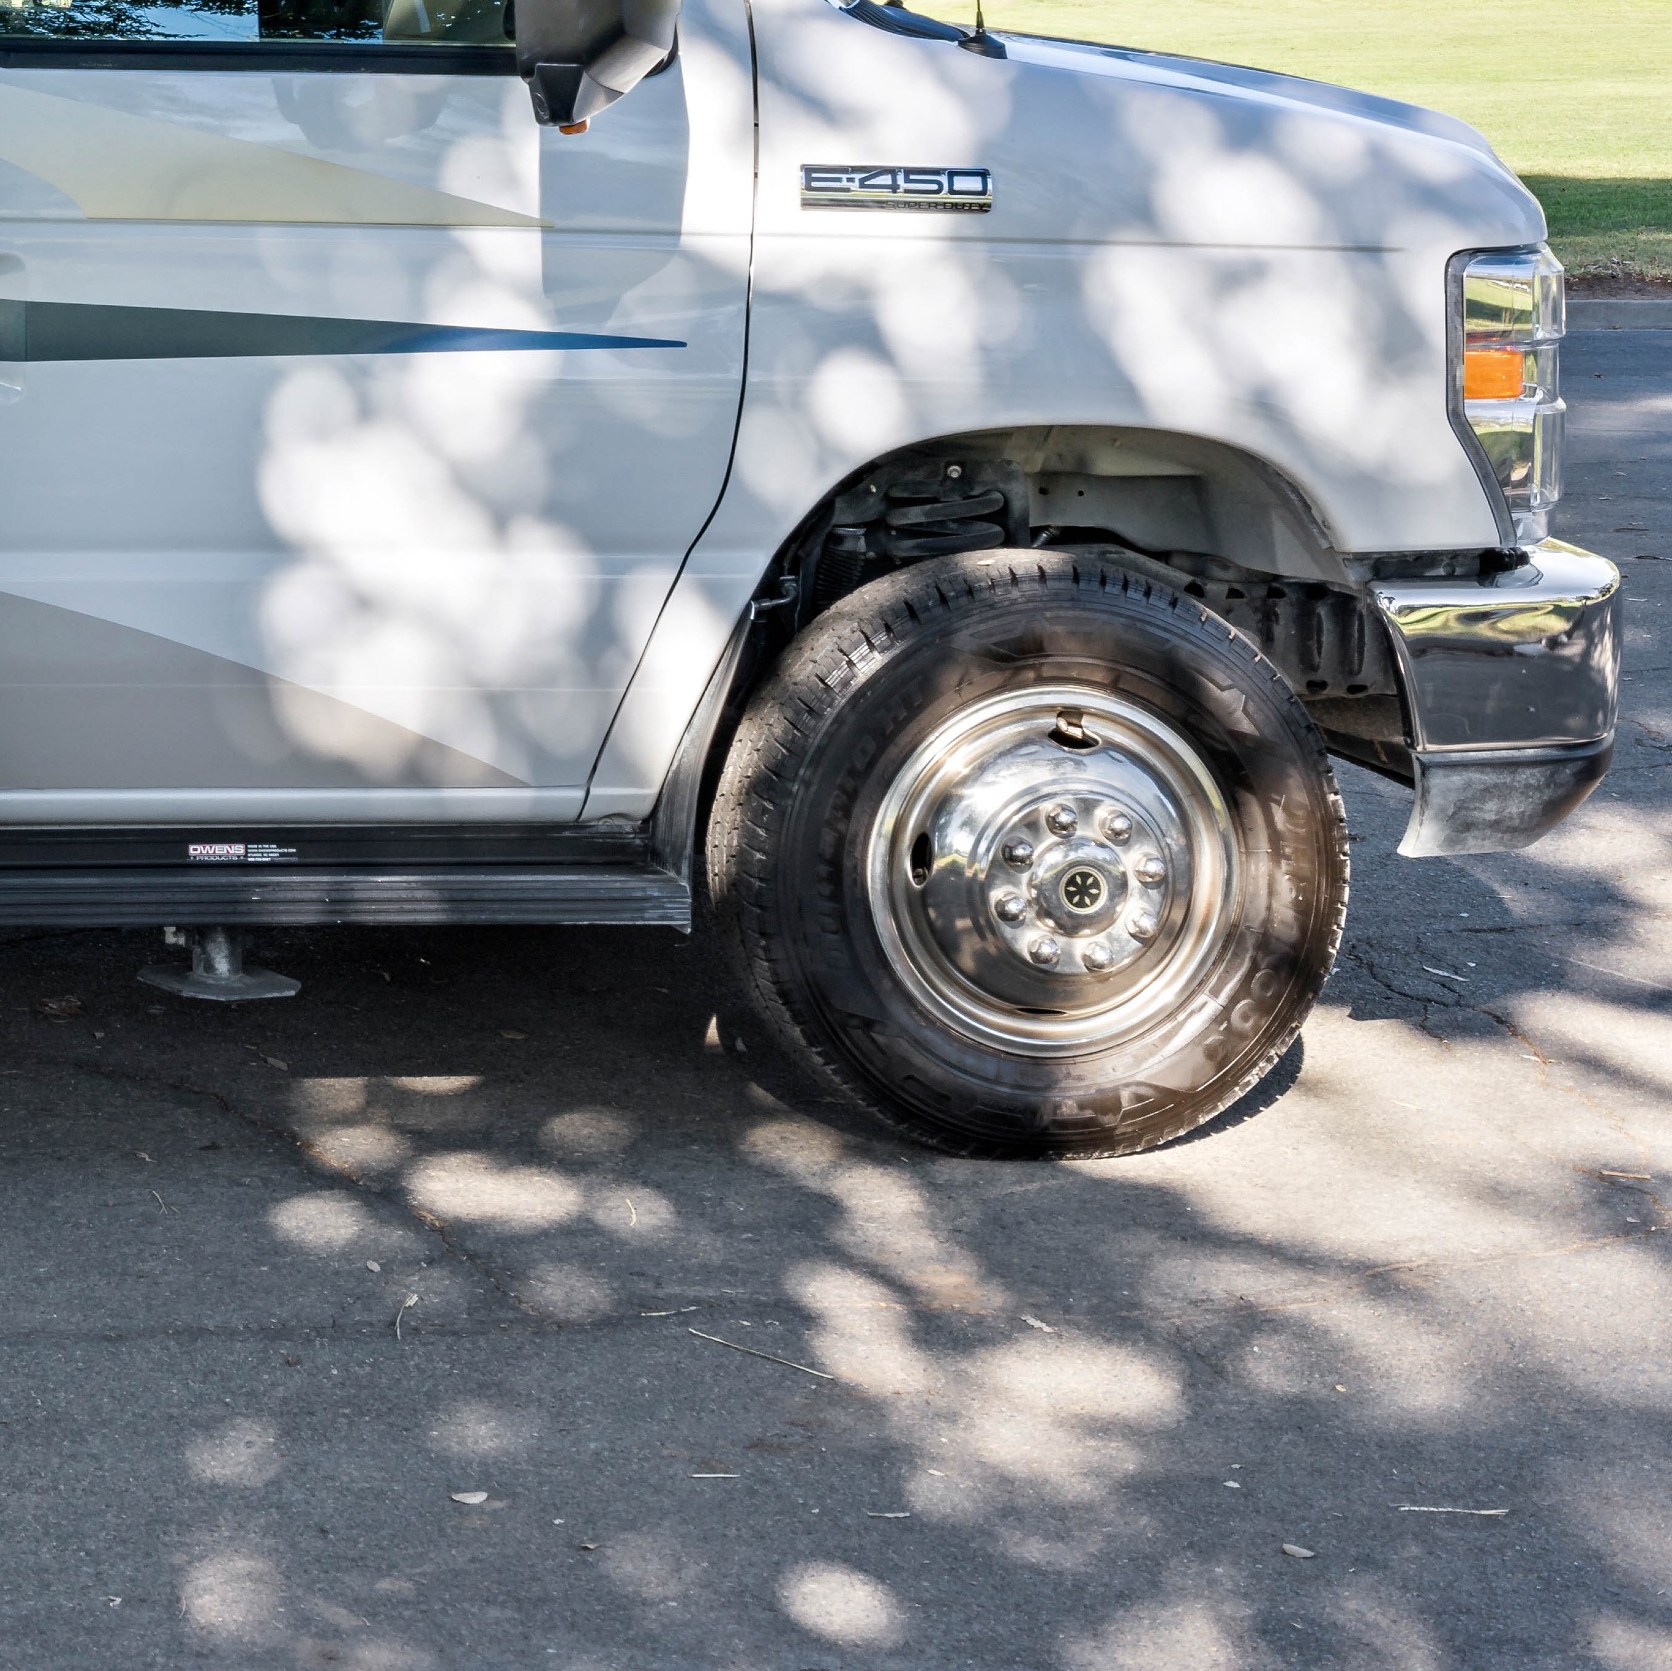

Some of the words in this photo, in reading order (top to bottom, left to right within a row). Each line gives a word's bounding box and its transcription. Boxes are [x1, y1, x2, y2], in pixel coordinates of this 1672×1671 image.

[804, 167, 990, 195] E-450
[885, 201, 938, 210] SUPER
[943, 202, 987, 210] DUTY
[190, 845, 244, 854] OWENS
